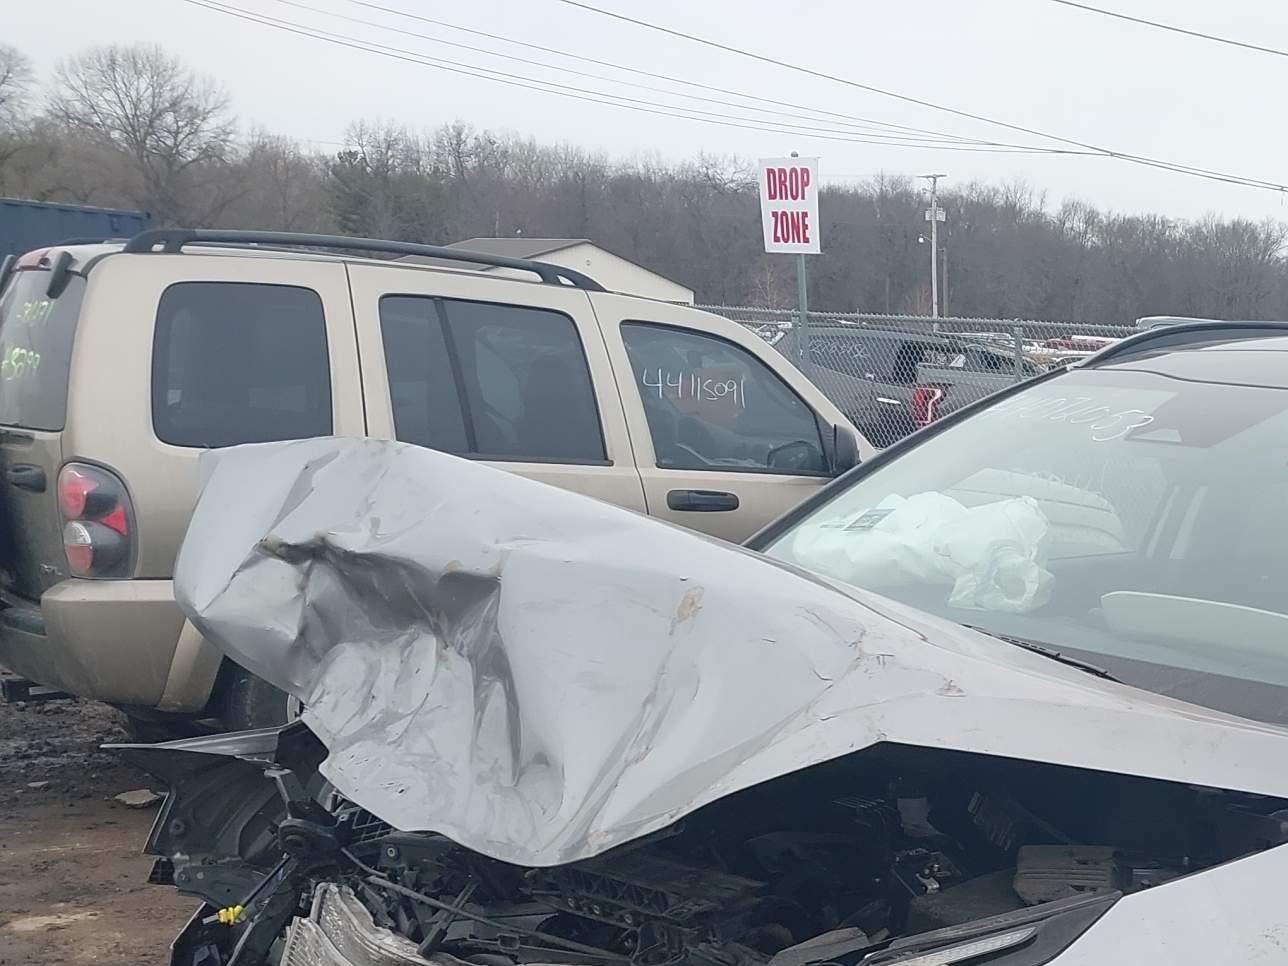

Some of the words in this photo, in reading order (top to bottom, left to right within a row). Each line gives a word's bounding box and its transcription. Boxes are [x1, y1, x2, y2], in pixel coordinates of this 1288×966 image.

[766, 167, 810, 201] DROP
[771, 211, 810, 244] ZONE
[642, 367, 746, 409] 44115091
